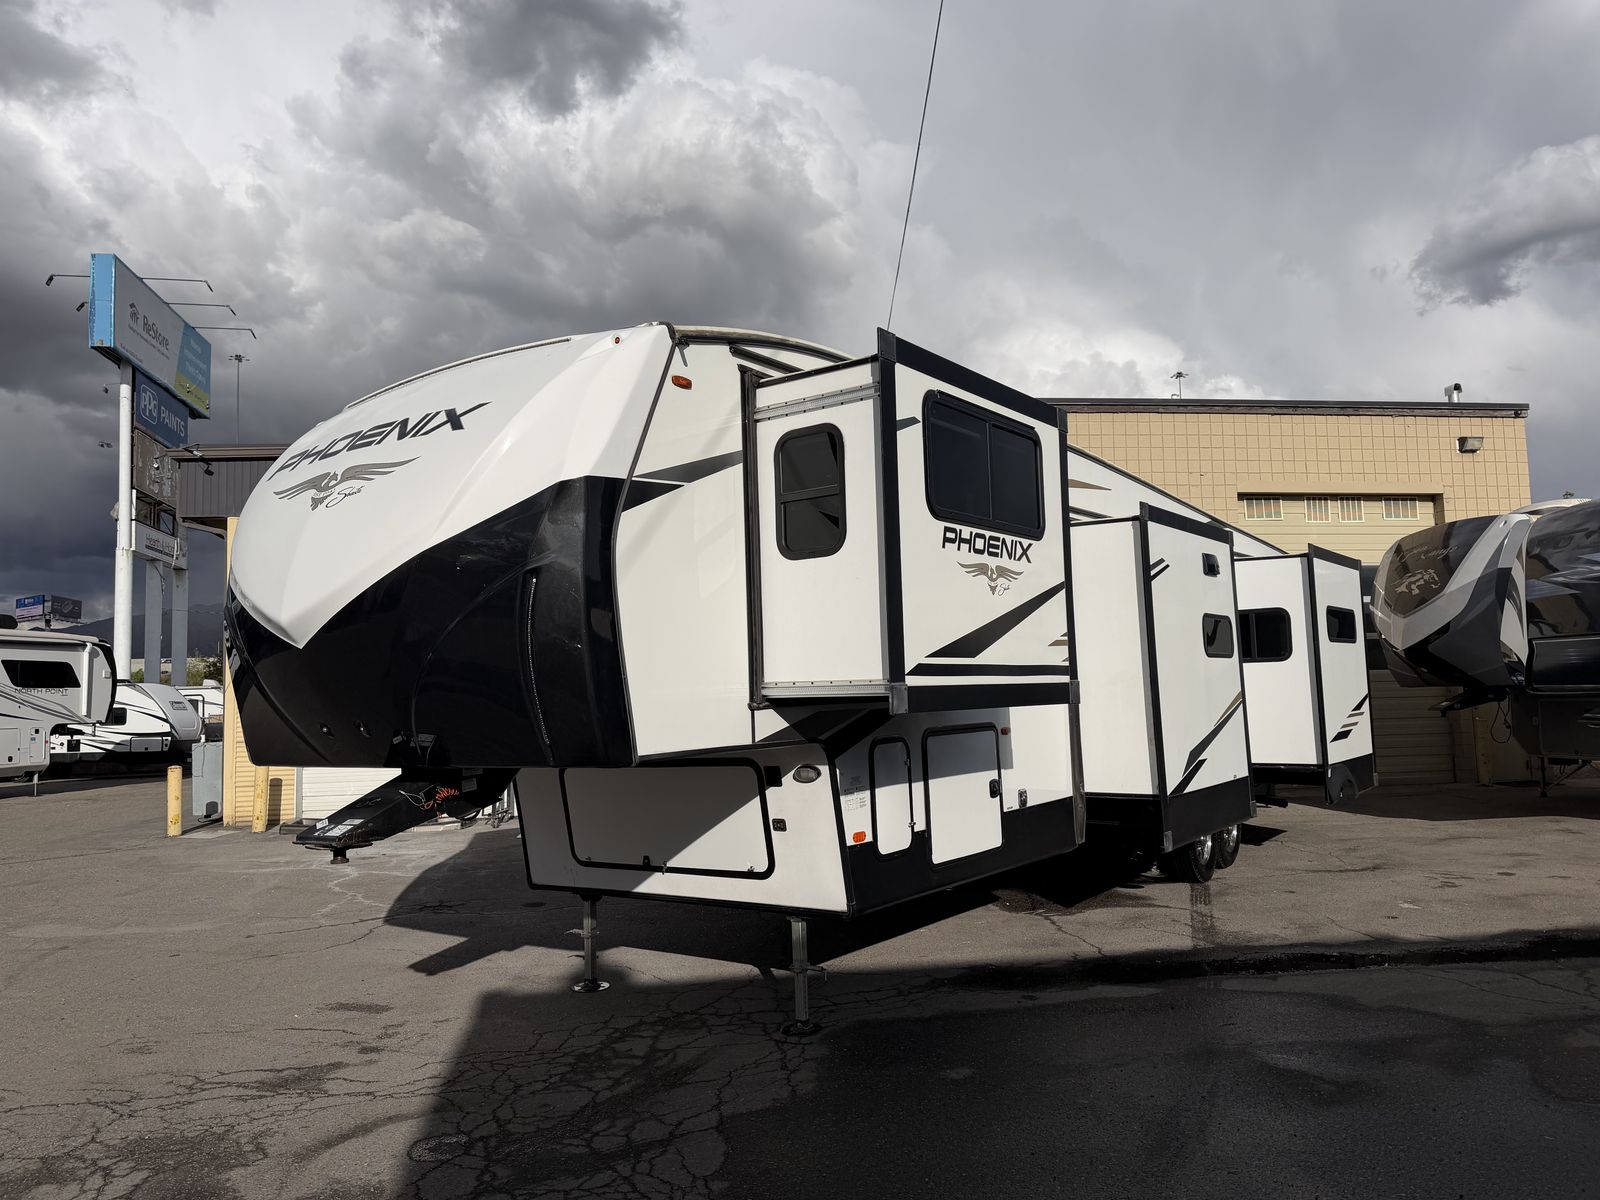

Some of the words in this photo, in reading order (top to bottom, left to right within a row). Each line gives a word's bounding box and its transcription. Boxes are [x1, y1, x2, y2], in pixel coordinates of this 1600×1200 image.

[143, 314, 169, 351] ReStore
[141, 390, 157, 417] PPG
[160, 405, 185, 437] PAINTS
[267, 401, 492, 481] PHOENIX
[942, 526, 1033, 563] PHOENIX
[14, 687, 42, 695] NORTH
[45, 688, 68, 696] POINT
